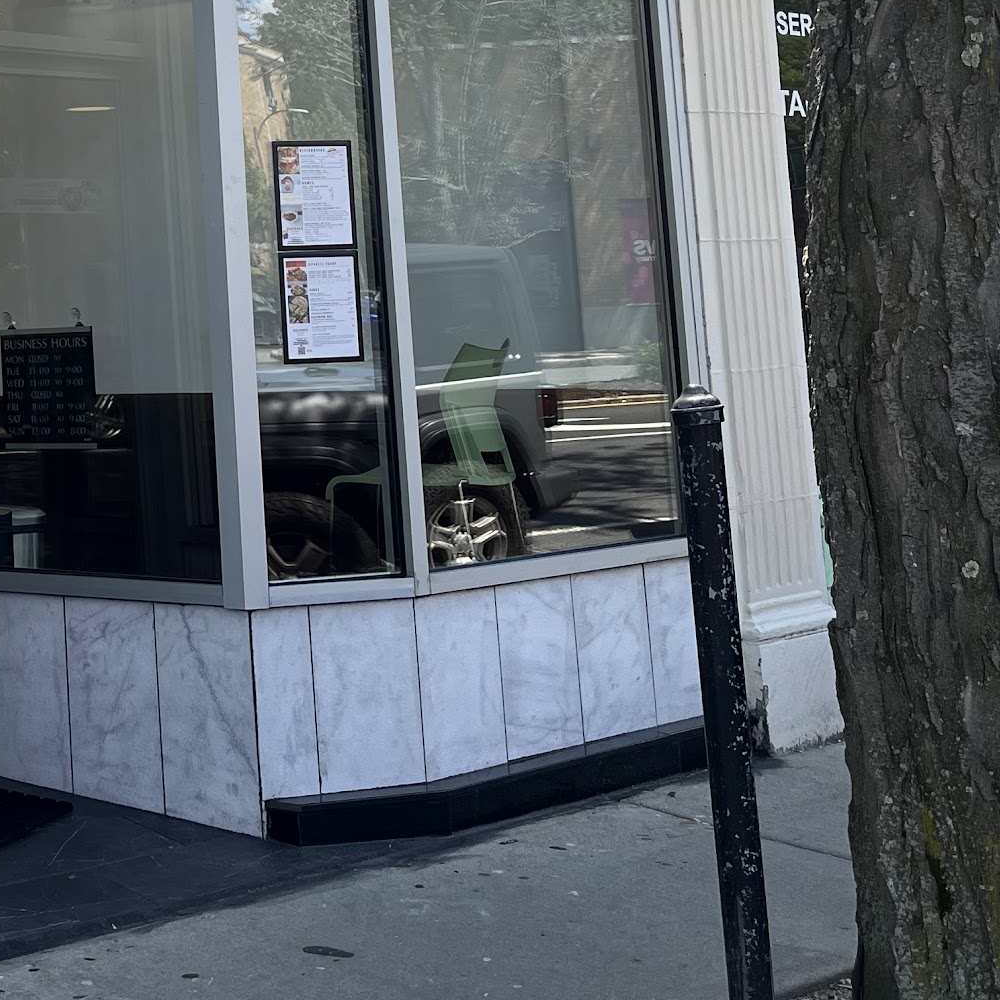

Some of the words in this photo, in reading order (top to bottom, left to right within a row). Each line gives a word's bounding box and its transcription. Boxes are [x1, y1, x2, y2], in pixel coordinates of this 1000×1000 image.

[4, 338, 48, 350] BUSINESS
[51, 337, 87, 348] HOURS
[5, 356, 24, 364] MON
[6, 368, 20, 376] TUE
[7, 379, 24, 388] WED
[7, 391, 23, 400] THU
[8, 415, 21, 423] SAT
[9, 427, 24, 435] SUN
